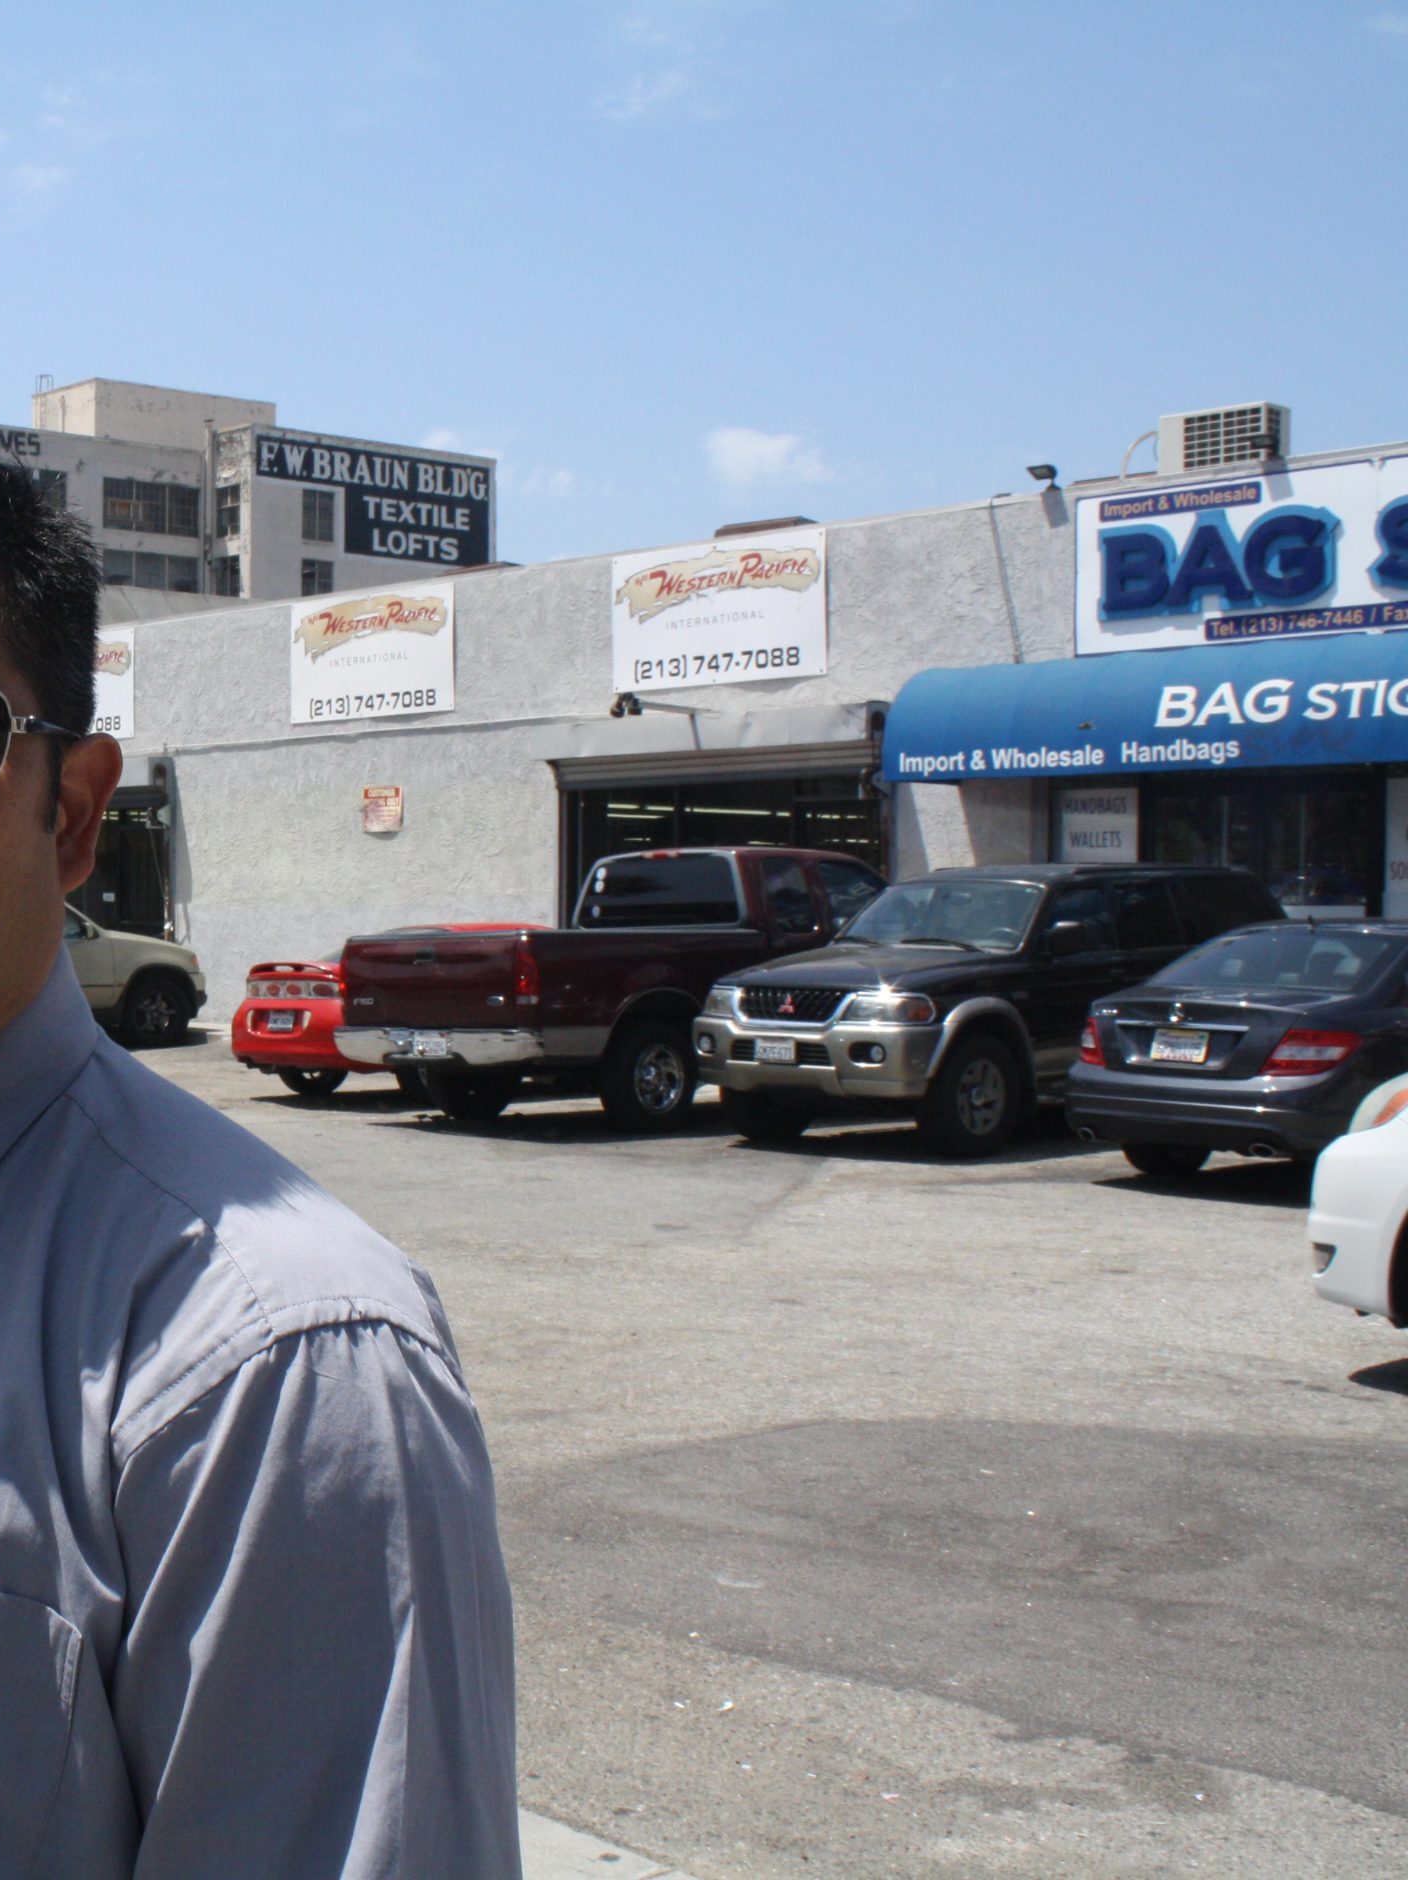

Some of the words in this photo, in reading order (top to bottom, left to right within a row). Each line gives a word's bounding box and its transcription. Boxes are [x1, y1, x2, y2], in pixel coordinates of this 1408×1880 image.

[312, 449, 409, 491] BRAUN
[362, 496, 470, 531] TEXTILE
[1104, 501, 1154, 519] Import
[1158, 497, 1170, 511] &
[1173, 486, 1257, 508] Wholesale
[372, 528, 459, 561] LOFTS
[1100, 508, 1336, 618] BAG
[665, 610, 764, 630] INTERNATIONAL
[1211, 621, 1238, 637] Tel.
[1243, 615, 1283, 635] (213)
[1288, 609, 1363, 630] 746-7446
[329, 651, 408, 668] INTERNATIONAL
[634, 654, 687, 683] (213)
[693, 646, 801, 675] 747-7088
[309, 695, 350, 719] (213)
[354, 689, 437, 713] 747-7088
[1155, 680, 1293, 728] BAG
[899, 752, 965, 775] Import
[970, 750, 986, 770] &
[992, 745, 1105, 769] Wholesale
[1121, 740, 1240, 765] Handbags
[1064, 796, 1128, 815] HANDBAGS
[1069, 830, 1123, 848] WALLETS
